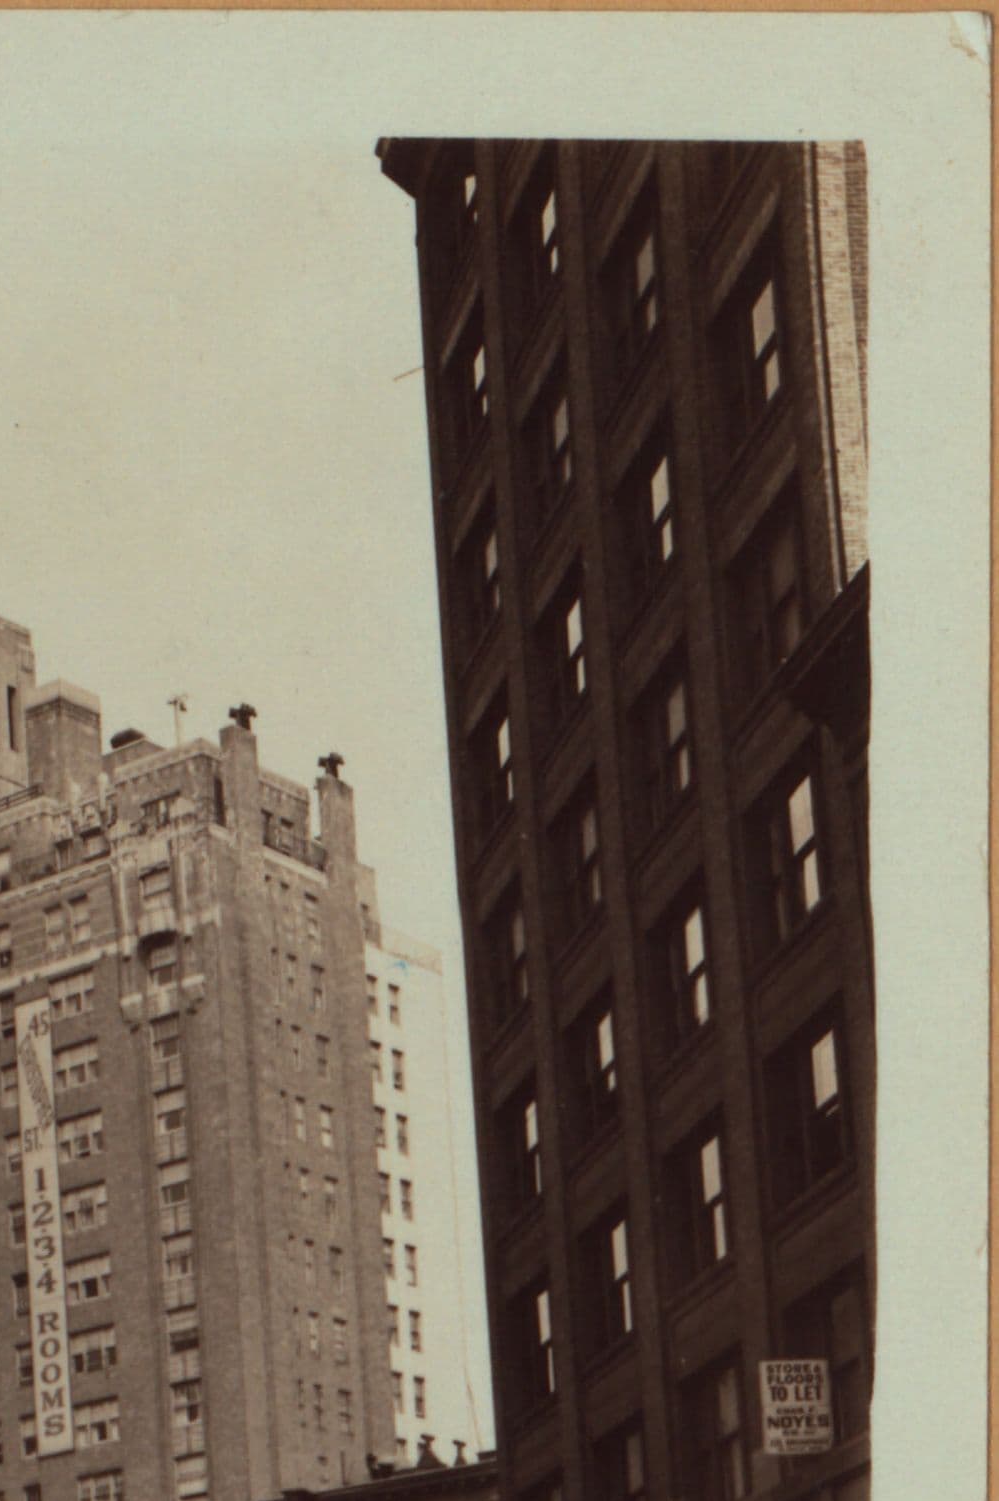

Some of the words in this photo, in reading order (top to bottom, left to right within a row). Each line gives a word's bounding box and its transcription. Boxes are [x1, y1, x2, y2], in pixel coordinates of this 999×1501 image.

[28, 1010, 50, 1038] 45
[37, 1310, 66, 1438] ROOMS
[769, 1386, 788, 1402] TO
[794, 1385, 822, 1402] LET
[766, 1415, 830, 1429] NOYES
